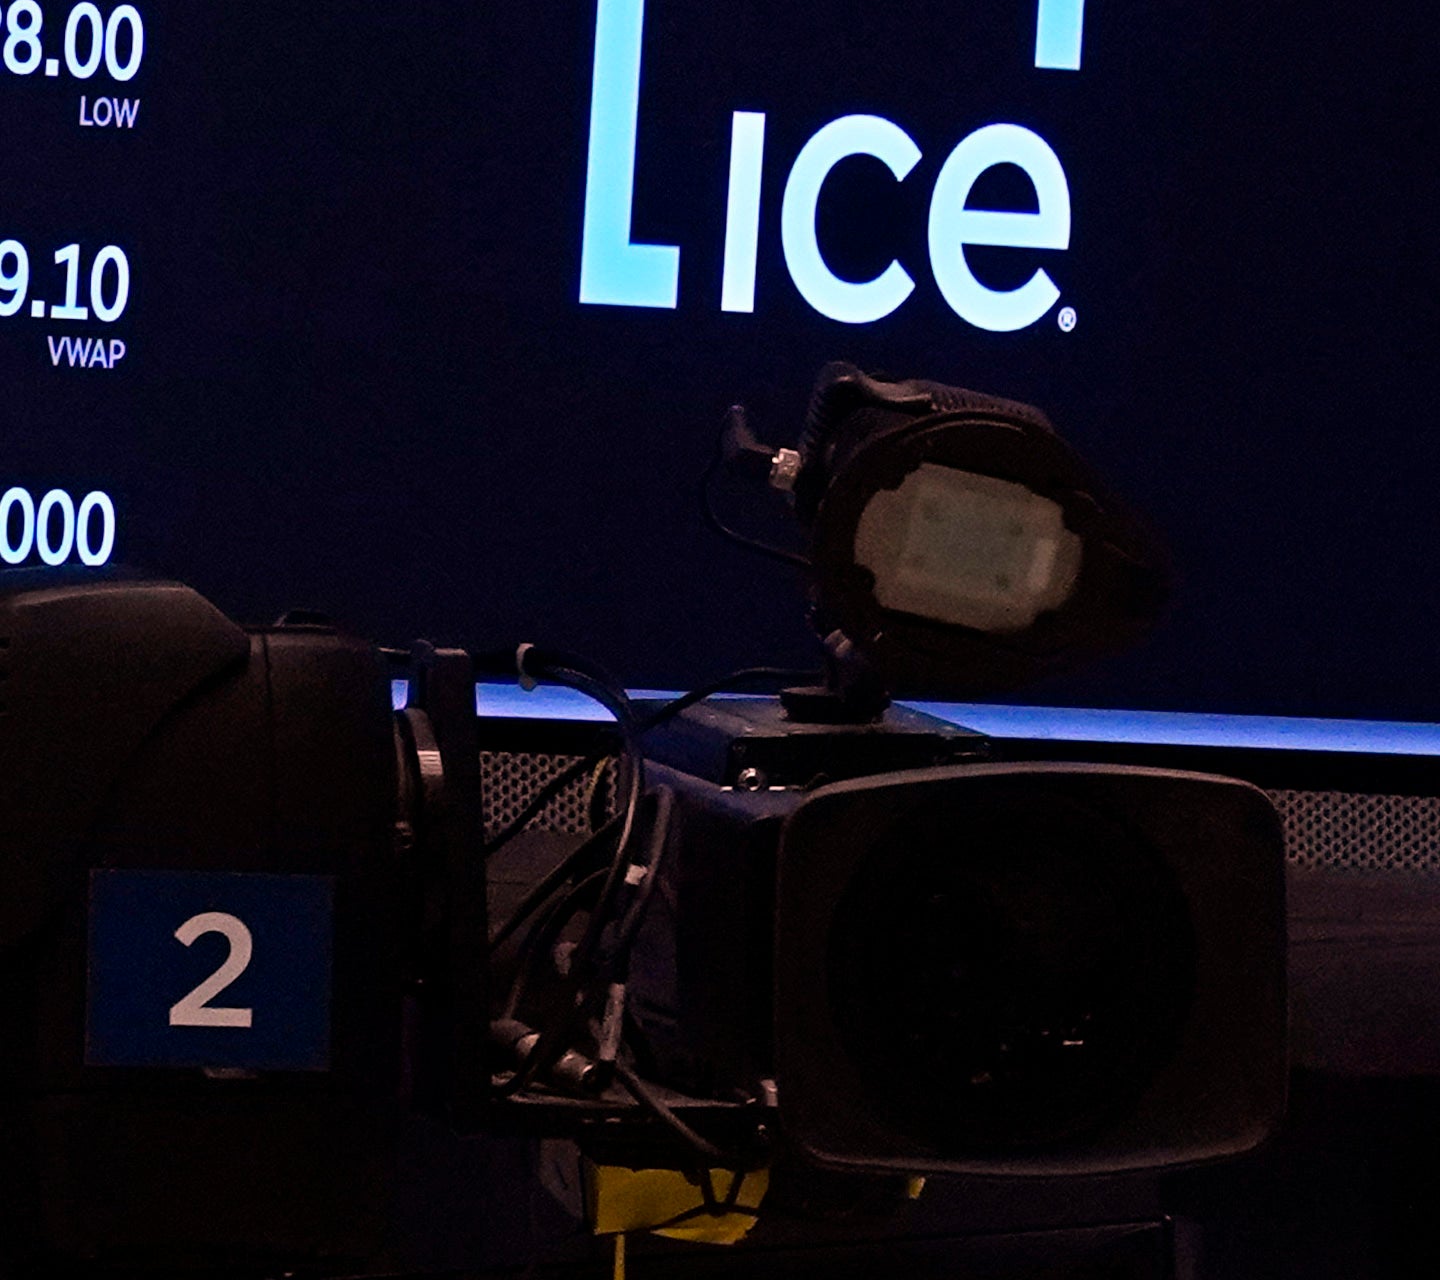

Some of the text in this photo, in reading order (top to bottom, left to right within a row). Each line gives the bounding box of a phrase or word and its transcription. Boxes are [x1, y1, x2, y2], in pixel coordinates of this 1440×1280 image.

[79, 95, 140, 128] LOW
[47, 335, 126, 369] VWAP
[168, 911, 254, 1029] 2
